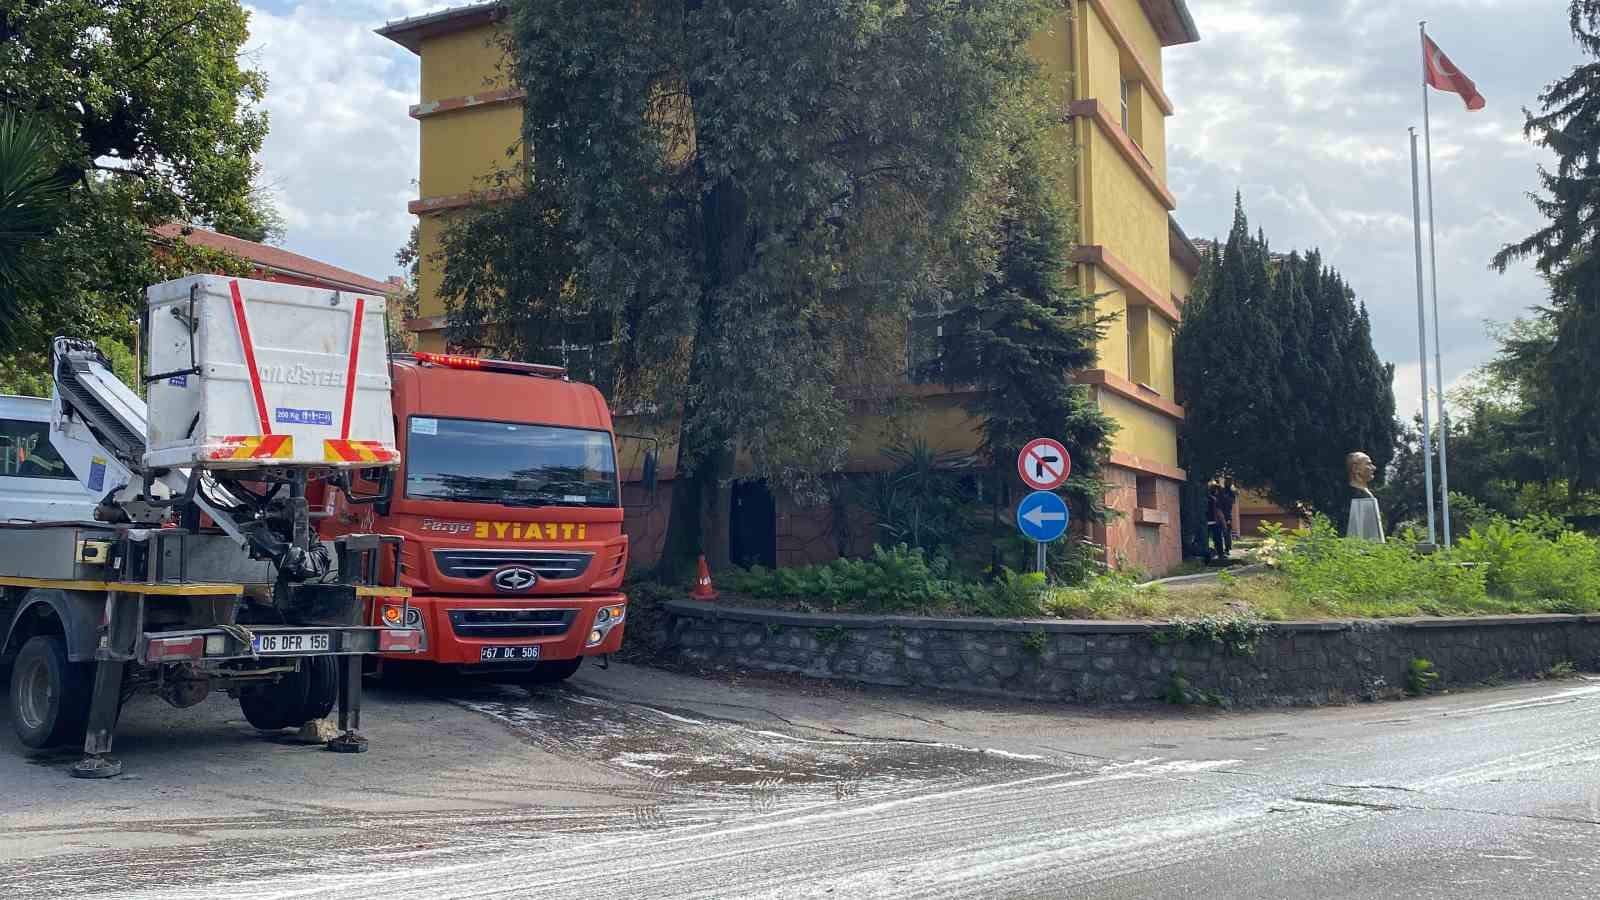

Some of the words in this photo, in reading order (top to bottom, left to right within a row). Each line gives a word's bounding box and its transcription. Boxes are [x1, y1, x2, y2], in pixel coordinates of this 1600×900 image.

[262, 636, 276, 650] 06
[281, 635, 303, 650] DFR
[310, 635, 328, 649] 156
[486, 647, 498, 658] 67
[504, 647, 516, 658] DC
[521, 647, 538, 658] 506
